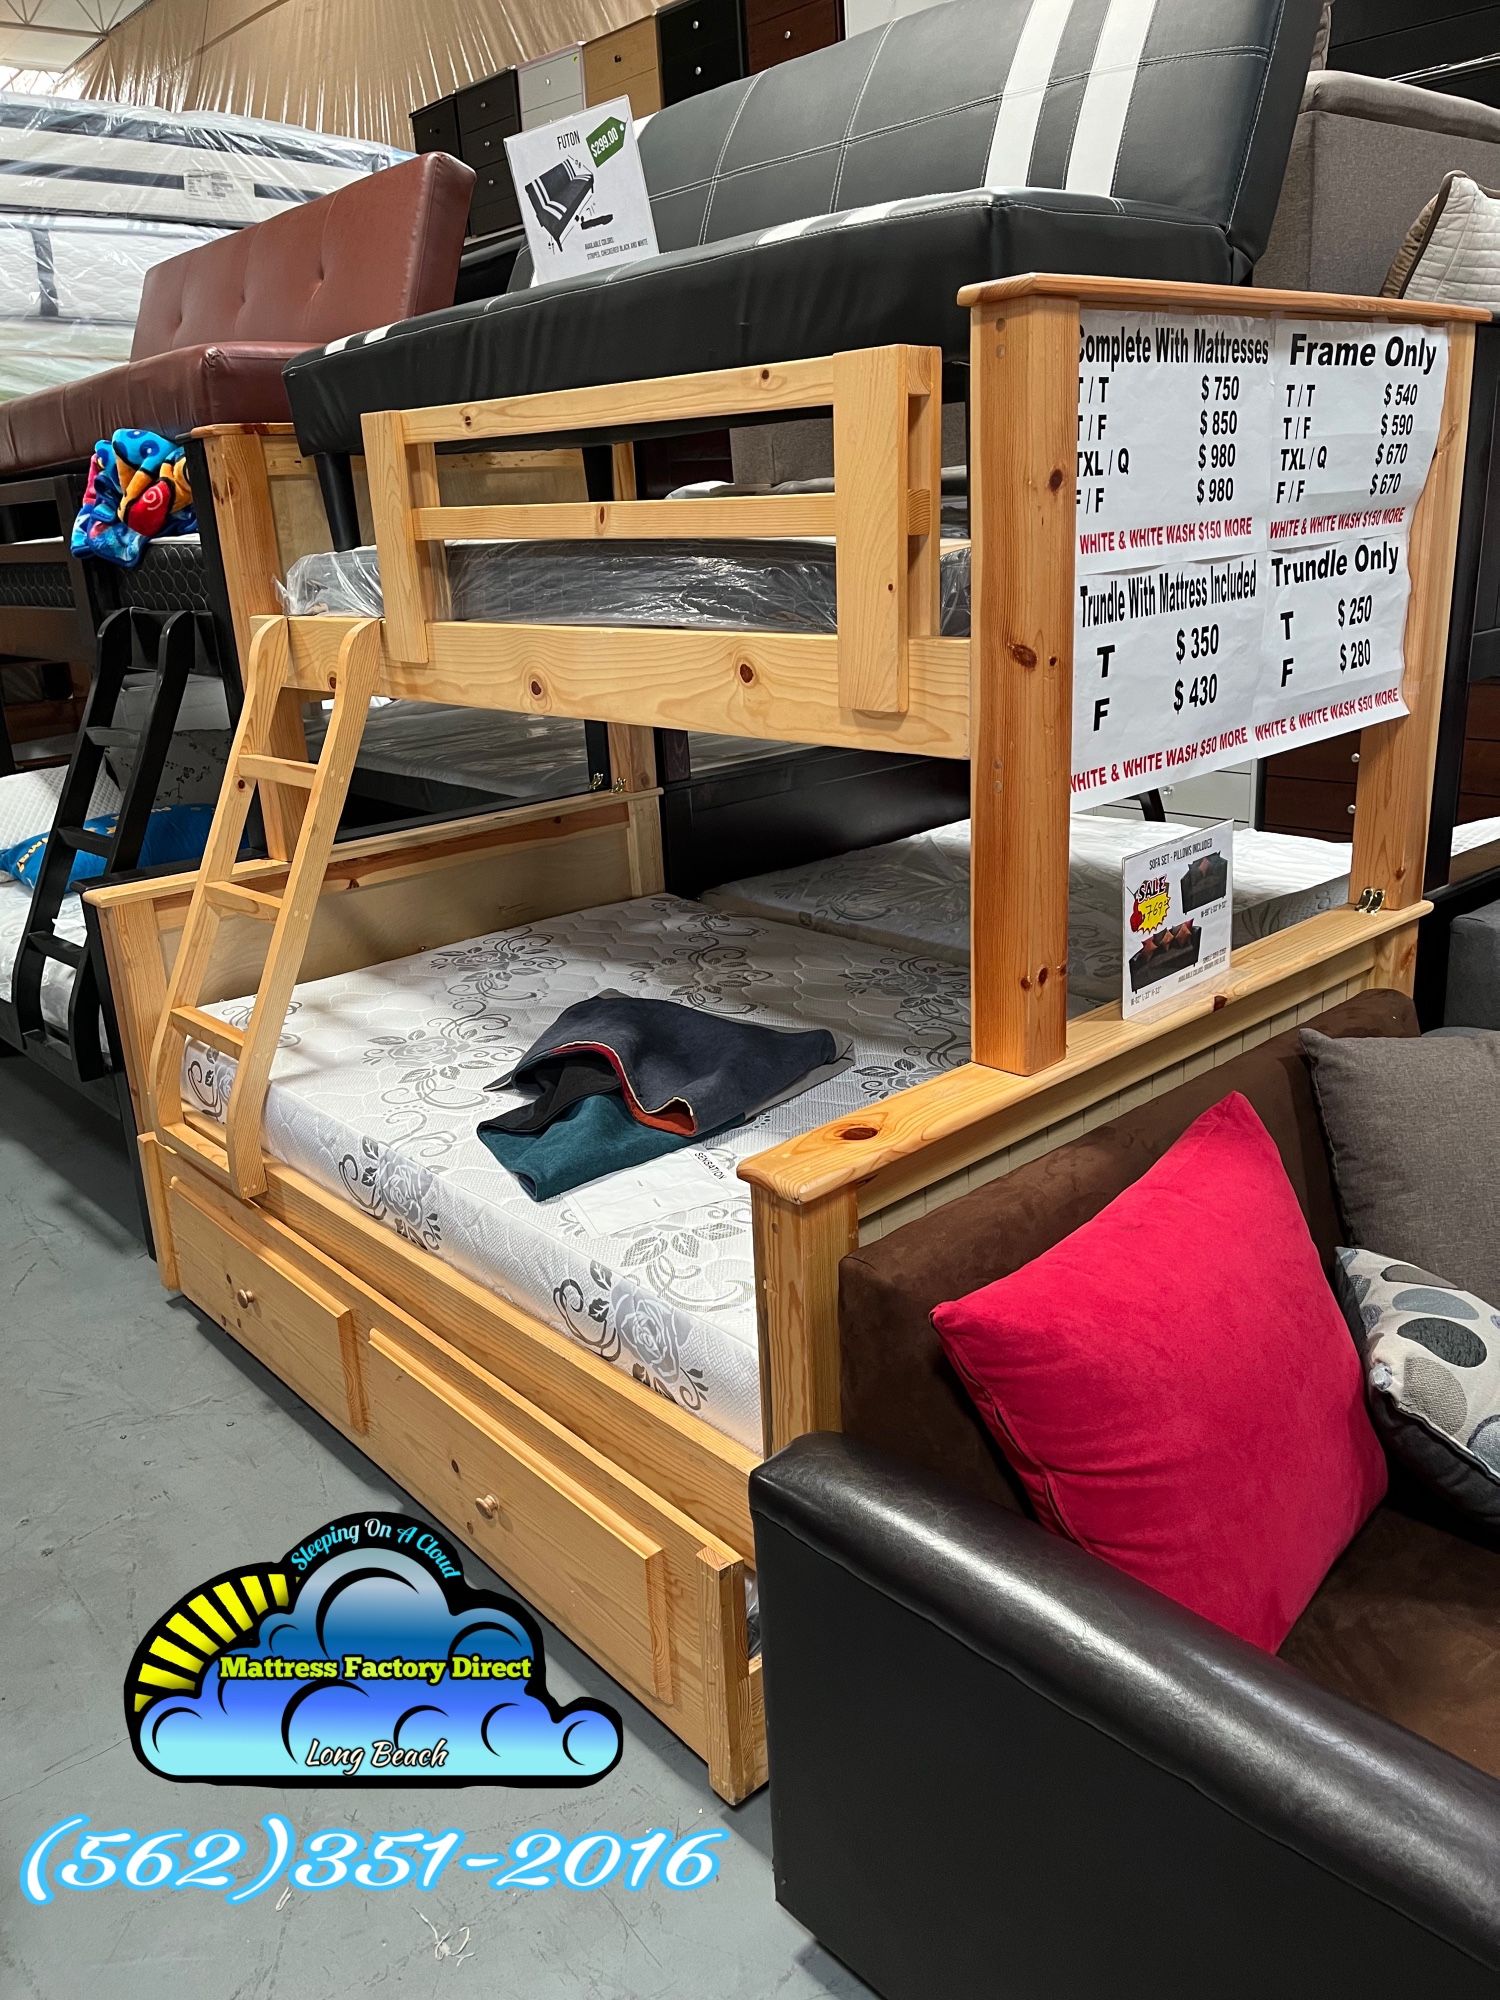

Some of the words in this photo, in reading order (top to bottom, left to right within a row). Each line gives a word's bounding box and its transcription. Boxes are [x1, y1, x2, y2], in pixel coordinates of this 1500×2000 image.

[557, 129, 581, 150] FUTON
[590, 127, 619, 158] $299.00
[1155, 327, 1188, 363] With
[1194, 328, 1269, 365] Mattresses
[1290, 333, 1376, 366] Frame
[1384, 336, 1437, 375] Only
[1079, 531, 1115, 554] WHITE
[1118, 530, 1127, 550] &
[1129, 526, 1163, 549] WHITE
[1166, 523, 1195, 544] WASH
[1199, 520, 1221, 542] $150
[1224, 517, 1252, 537] MORE
[1270, 519, 1300, 539] WHITE
[1300, 518, 1307, 535] &
[1309, 515, 1337, 534] WHITE
[1337, 511, 1361, 530] WASH
[1362, 509, 1381, 527] $150
[1382, 507, 1406, 524] MORE
[1271, 549, 1348, 587] Trundle
[1354, 541, 1399, 575] Only
[1080, 581, 1125, 628] Trundle
[1128, 575, 1156, 619] With
[1159, 572, 1207, 614] Mattress
[1210, 559, 1257, 604] Included
[1280, 611, 1294, 640] T
[1097, 645, 1115, 678] T
[1281, 658, 1294, 687] F
[1093, 698, 1110, 732] F
[1255, 718, 1287, 742] WHITE
[1289, 716, 1297, 732] &
[1299, 706, 1329, 729] WHITE
[1330, 699, 1356, 720] WASH
[1357, 695, 1373, 713] $50
[1374, 687, 1399, 707] MORE
[1071, 767, 1107, 793] WHITE
[1111, 764, 1120, 782] &
[1123, 752, 1163, 778] WHITE
[1166, 742, 1199, 767] WASH
[1200, 736, 1217, 758] $50
[1219, 727, 1248, 750] MORE
[1149, 857, 1160, 870] SOFA
[1161, 853, 1170, 866] SET
[1173, 845, 1192, 861] PILLOWS
[1137, 874, 1167, 903] SALE
[695, 1152, 727, 1180] SENSATION
